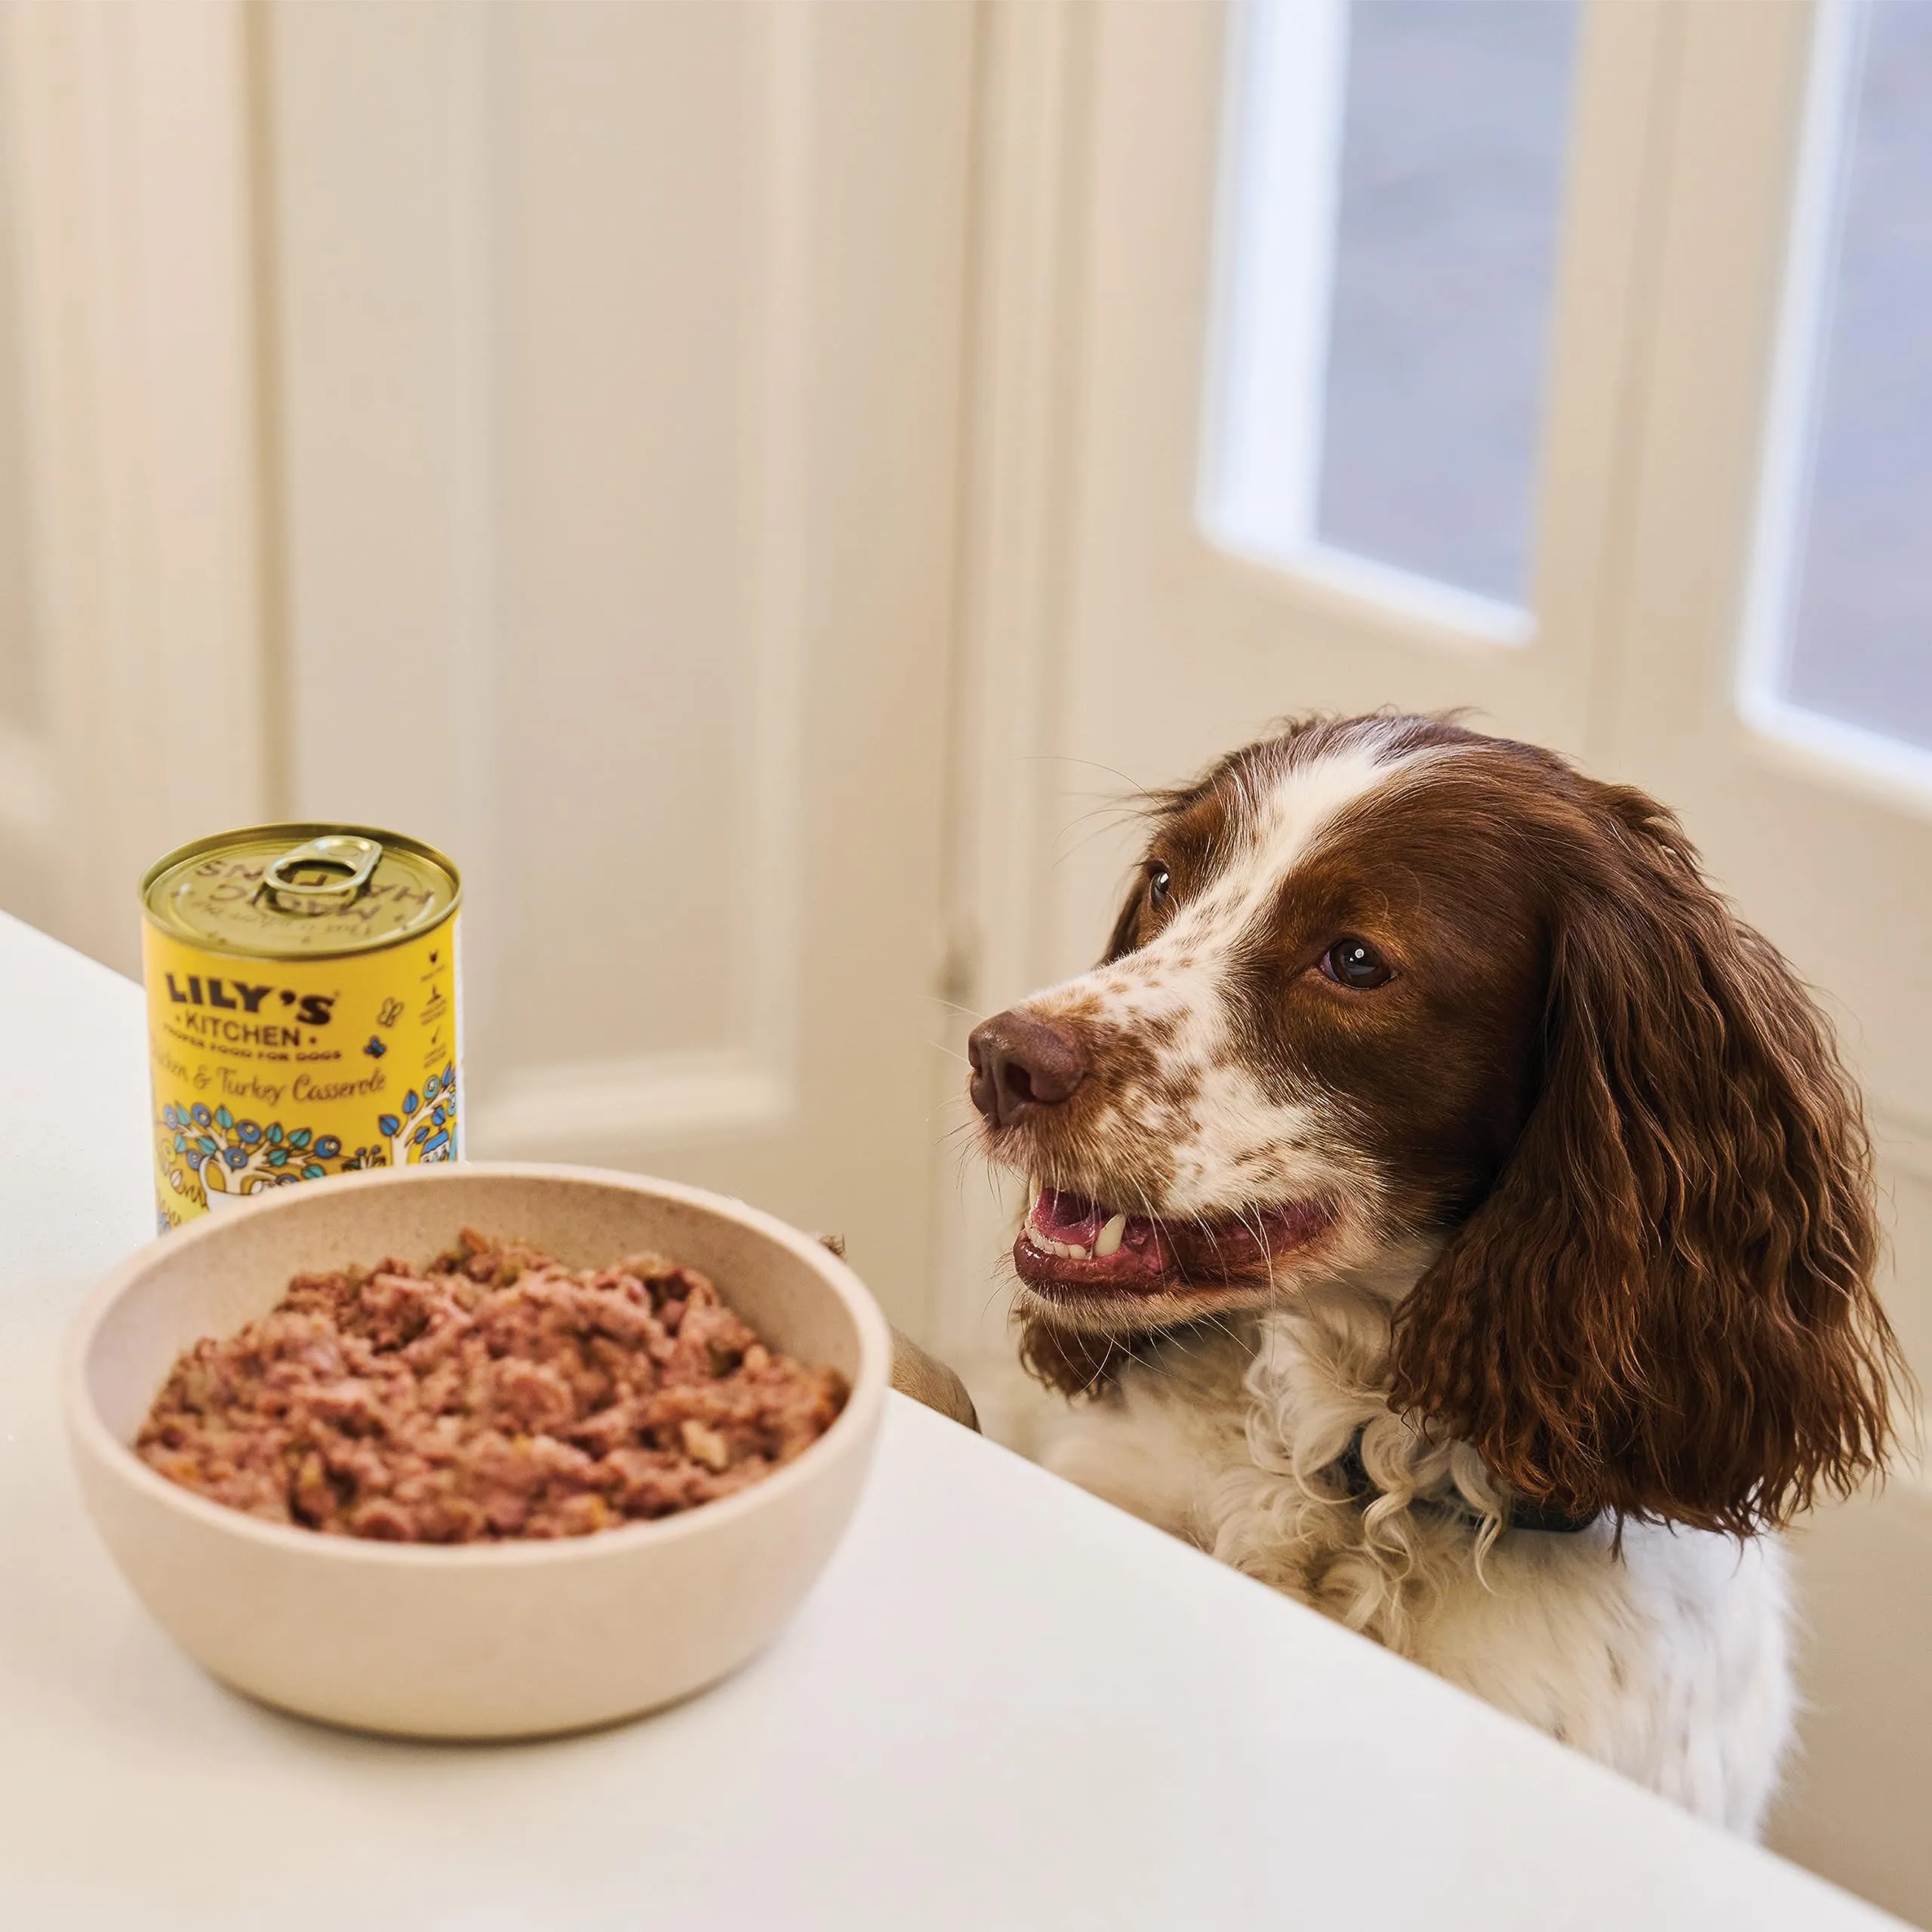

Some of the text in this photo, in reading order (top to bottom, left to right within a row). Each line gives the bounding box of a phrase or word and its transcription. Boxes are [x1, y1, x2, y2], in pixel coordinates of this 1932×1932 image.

[165, 973, 335, 1026] LILY'S
[186, 1011, 300, 1047] KITCHEN
[257, 1050, 289, 1062] FOR
[295, 1050, 341, 1062] DOGS
[193, 1064, 212, 1090] &
[215, 1065, 287, 1106] Turkey
[292, 1066, 386, 1103] Casserole
